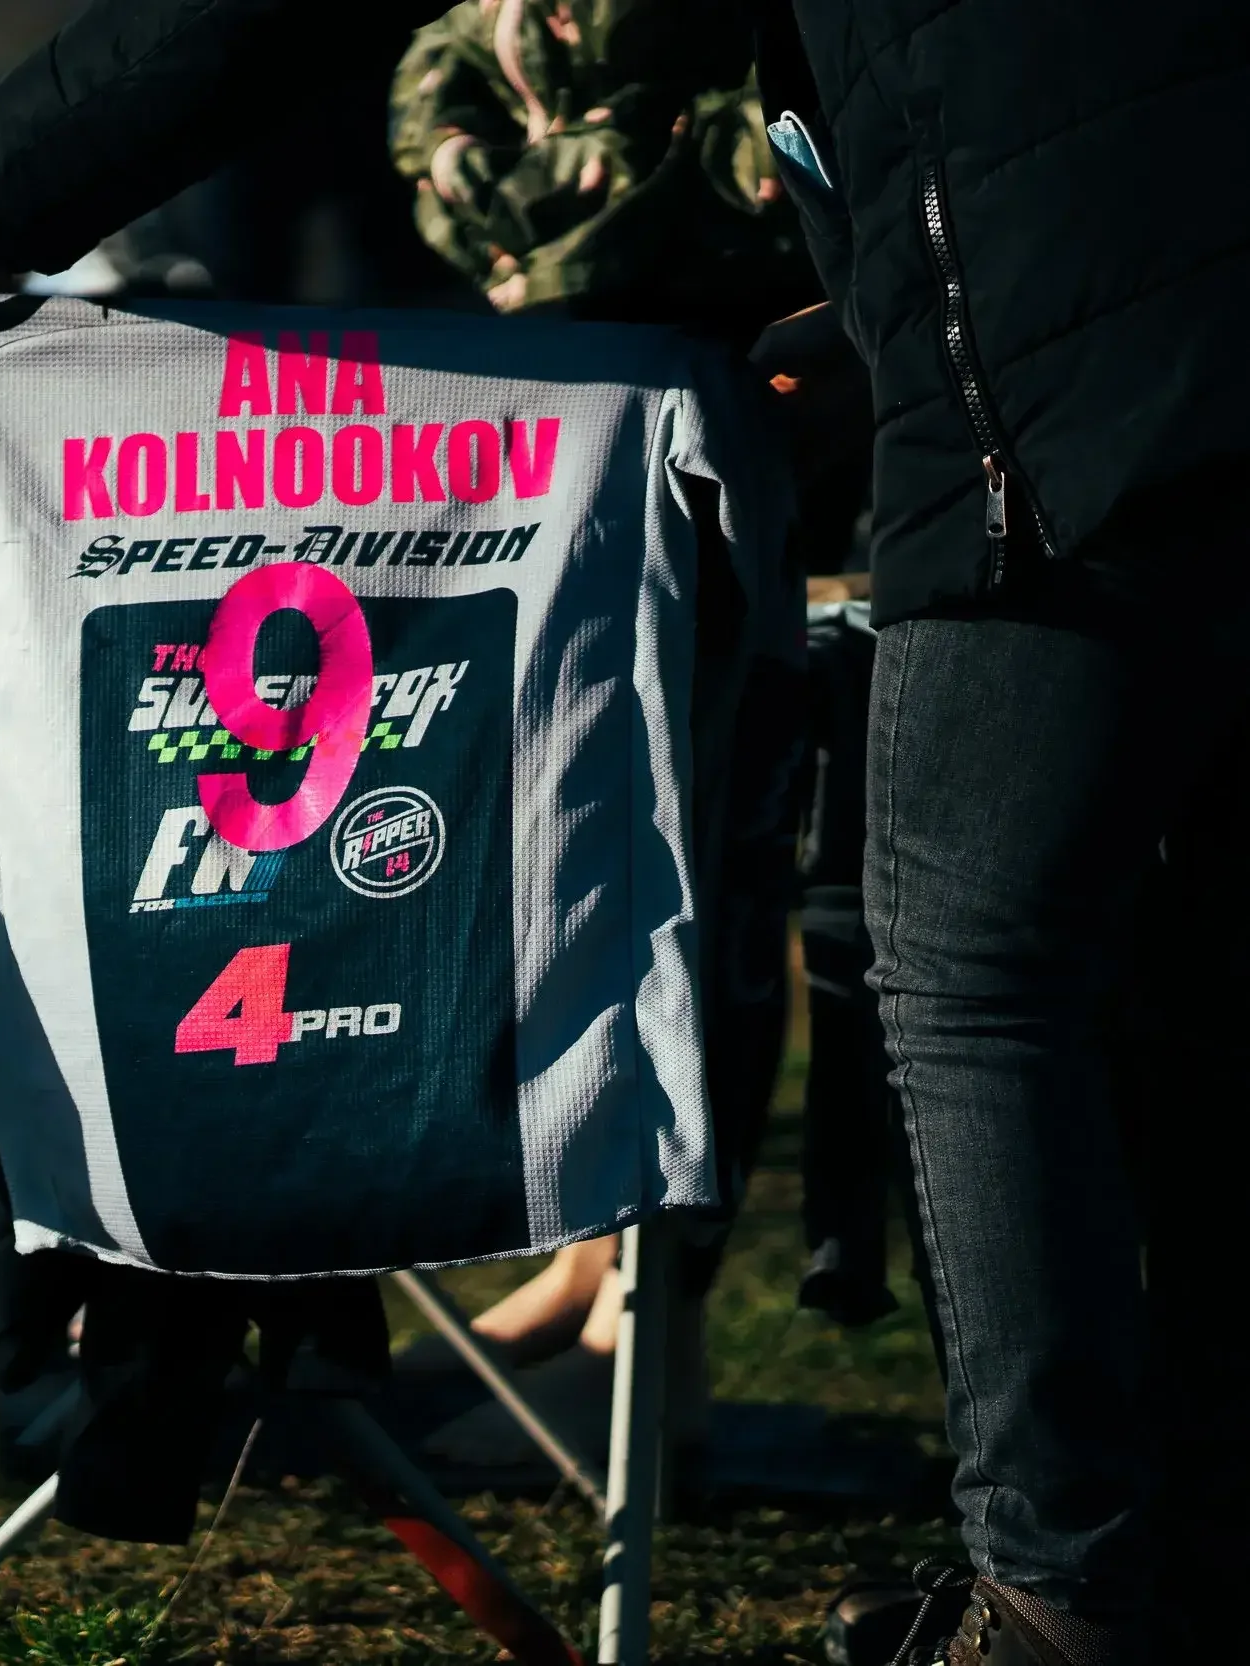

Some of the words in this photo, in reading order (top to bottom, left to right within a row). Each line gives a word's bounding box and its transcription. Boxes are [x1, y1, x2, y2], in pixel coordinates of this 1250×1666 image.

[218, 330, 386, 416] ANA
[62, 417, 561, 521] KOLNOOKOV
[152, 642, 207, 673] TH
[127, 674, 321, 733] SUE
[196, 561, 374, 852] 9
